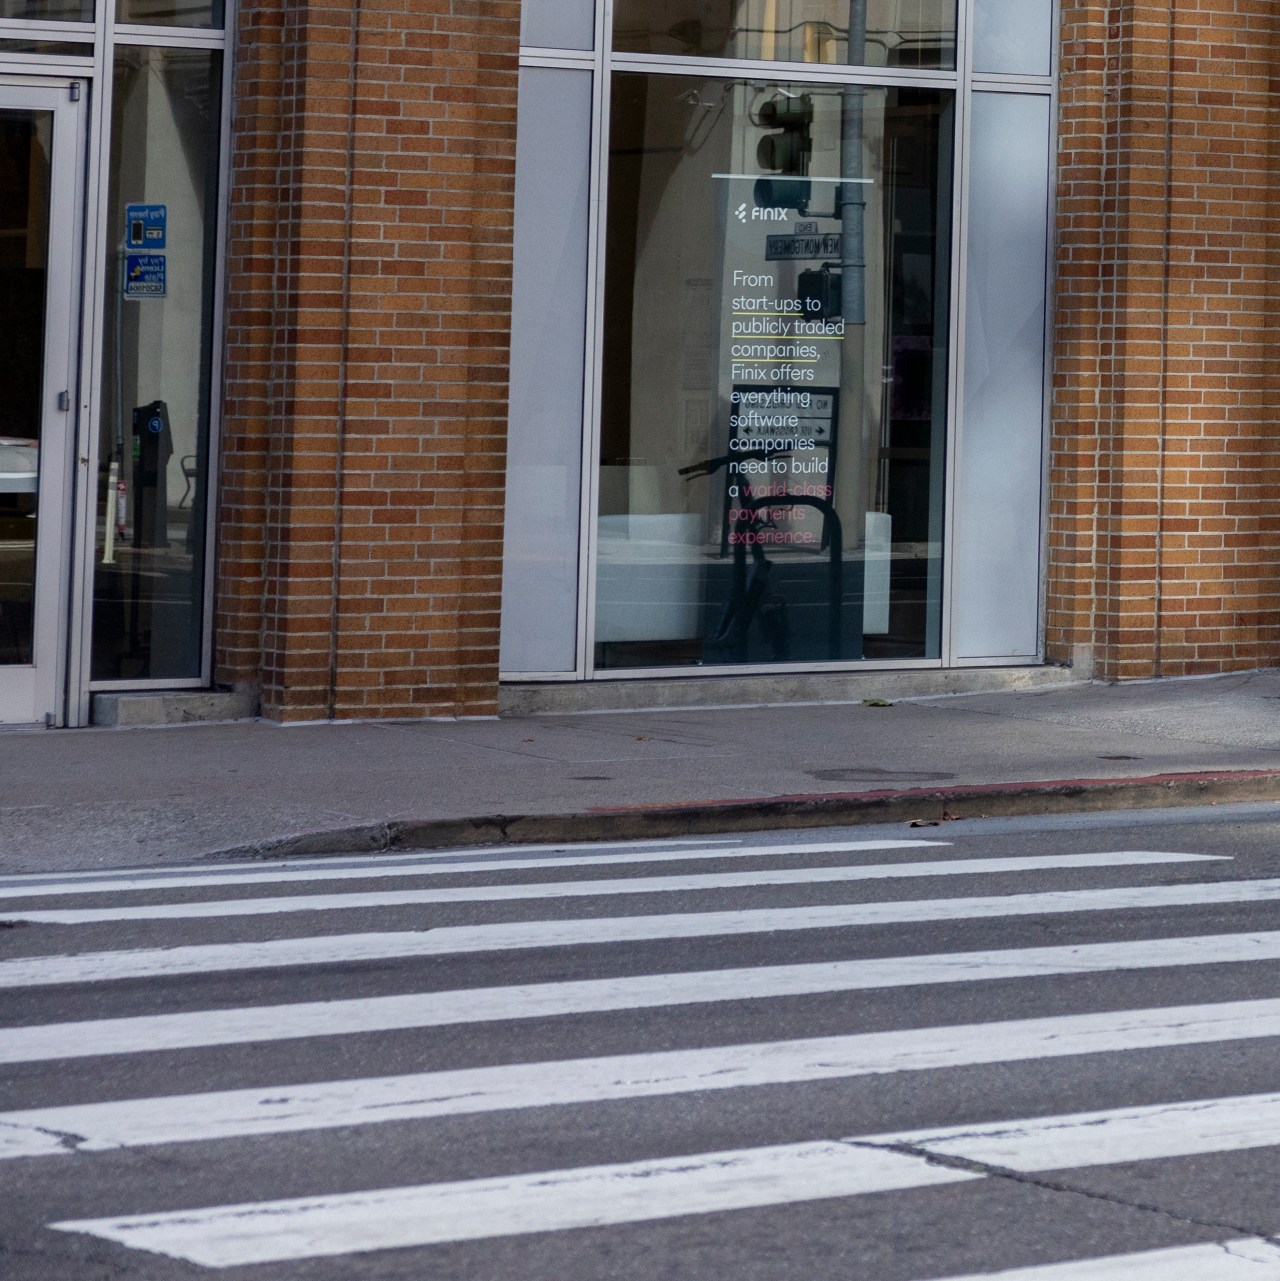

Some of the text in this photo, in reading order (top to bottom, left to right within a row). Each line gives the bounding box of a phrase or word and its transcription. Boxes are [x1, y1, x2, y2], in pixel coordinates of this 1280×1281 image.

[751, 207, 788, 220] FINIX
[733, 270, 773, 287] From
[732, 296, 821, 313] start-ups to
[732, 318, 845, 337] publicly traded
[731, 341, 820, 360] companies,
[732, 364, 814, 380] Finix offers
[730, 387, 810, 407] everything
[730, 410, 798, 427] software
[730, 434, 815, 453] companies
[729, 457, 828, 474] need to build
[728, 481, 832, 497] a world-class
[728, 507, 805, 524] payments
[728, 528, 816, 544] experience.
